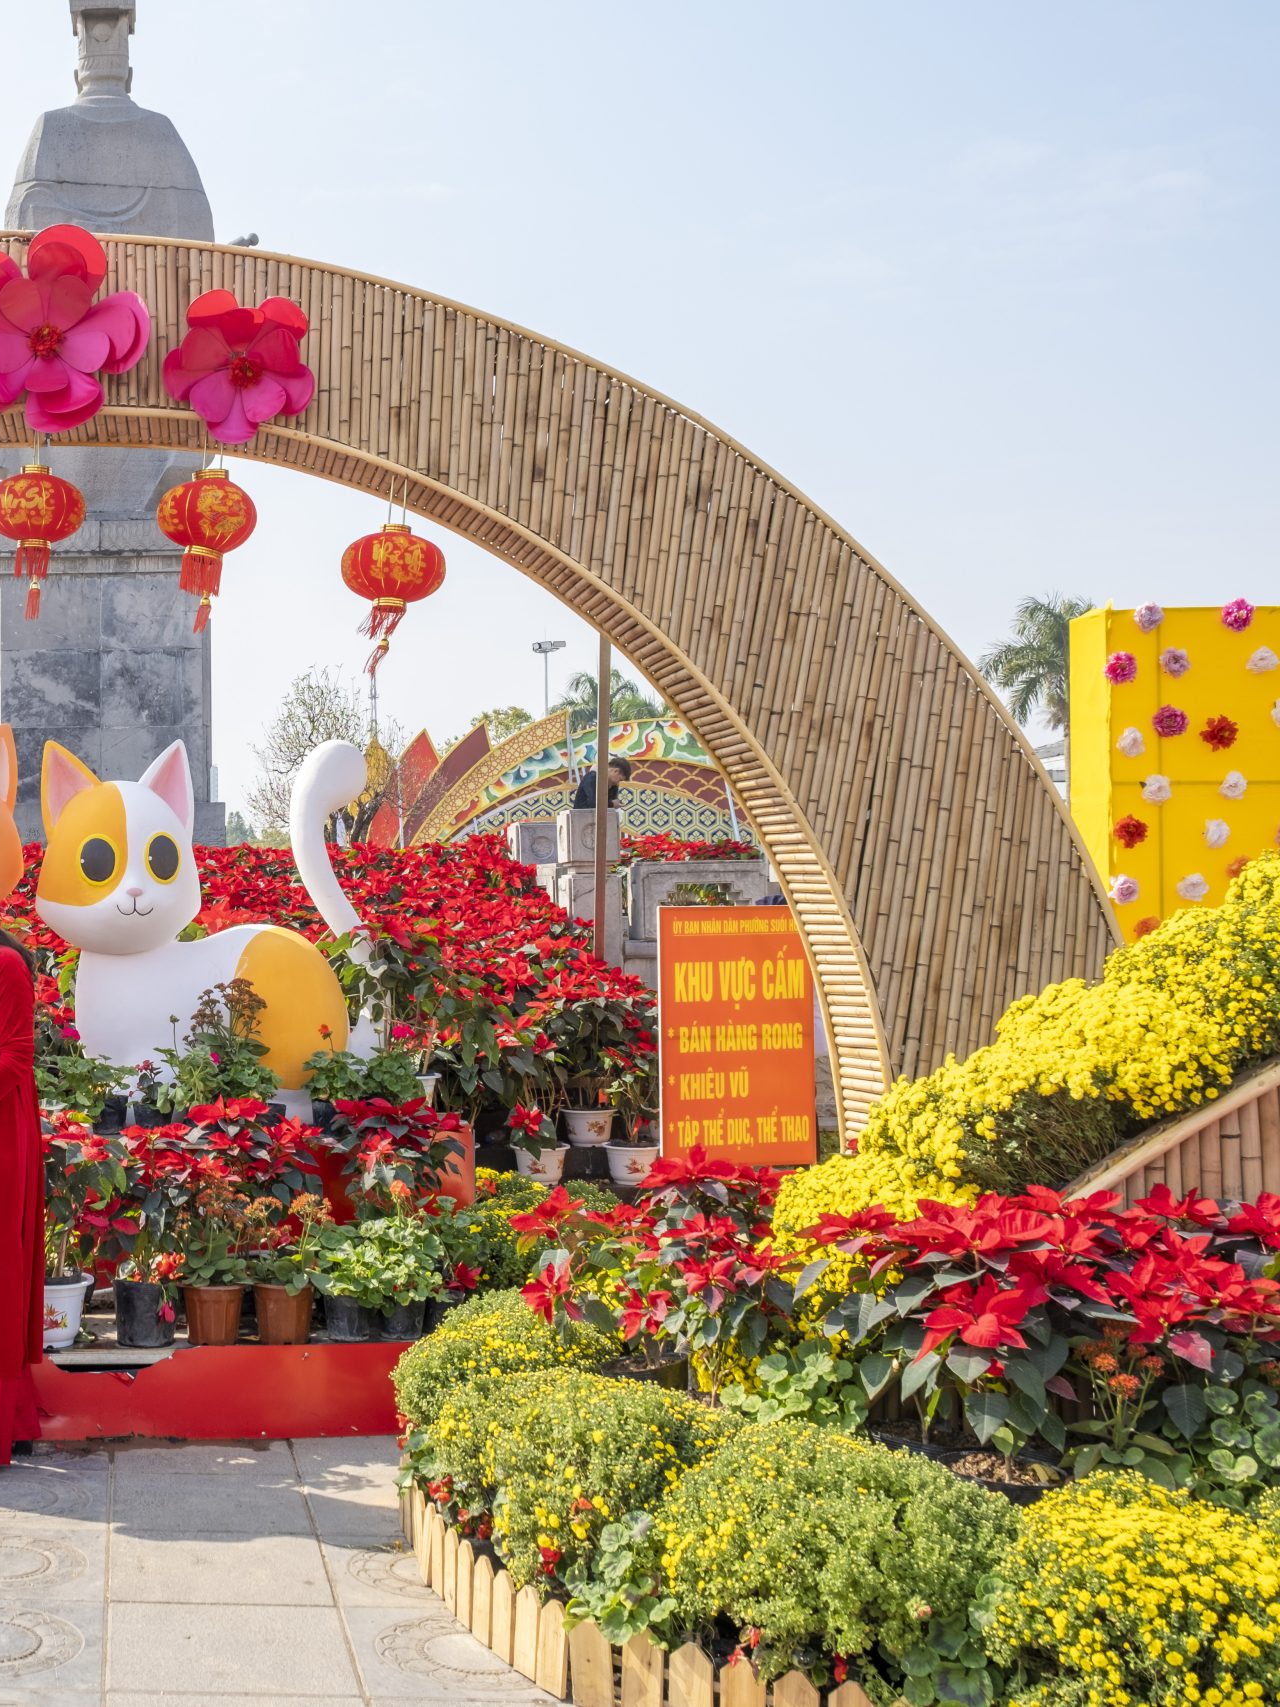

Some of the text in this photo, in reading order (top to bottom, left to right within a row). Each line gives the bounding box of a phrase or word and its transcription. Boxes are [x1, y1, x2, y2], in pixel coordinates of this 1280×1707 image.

[684, 920, 700, 934] BAN
[701, 917, 721, 933] NHÂN
[723, 917, 738, 933] DÂN
[740, 916, 769, 932] PHƯỜNG
[770, 914, 787, 932] SUỐI
[674, 945, 805, 1010] KHU VỰC CẤM
[679, 1019, 803, 1053] BÁN HÀNG RONG
[680, 1065, 749, 1100] KHIÊU VŨ
[703, 1108, 724, 1146] THỂ
[727, 1118, 754, 1151] DỤC,
[756, 1105, 778, 1143] THỂ
[780, 1115, 810, 1142] THAO
